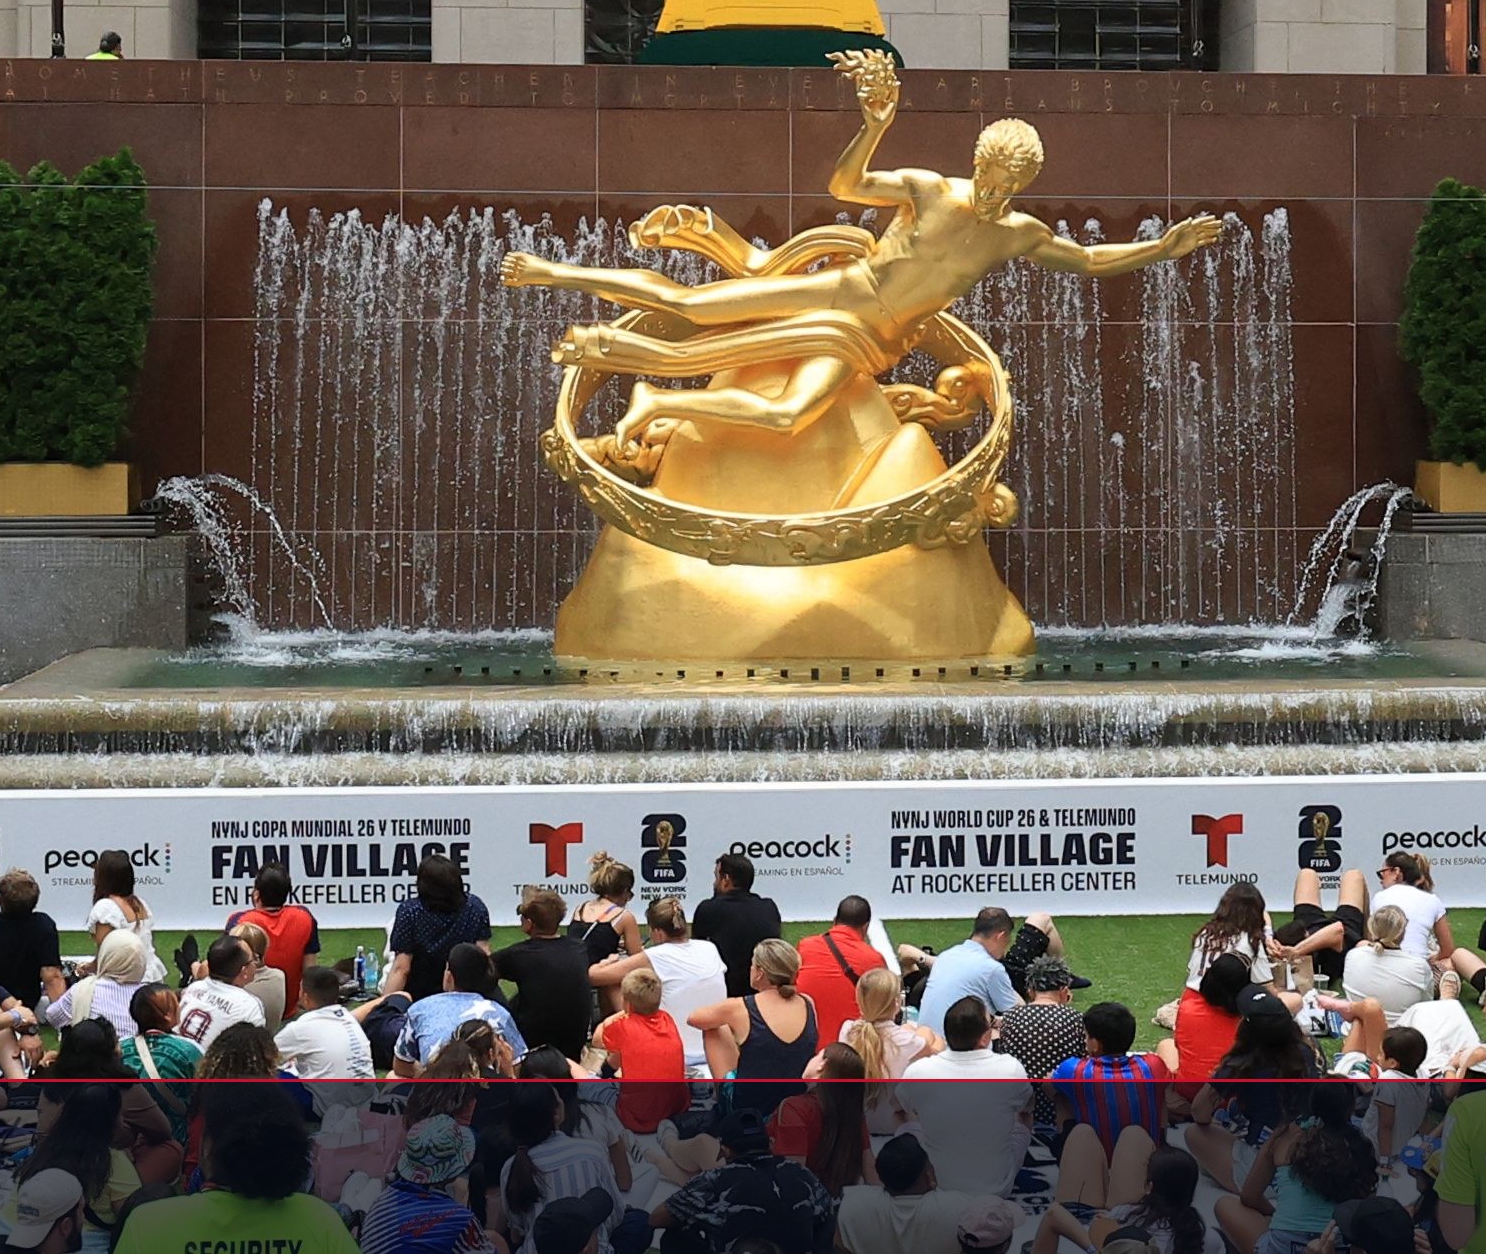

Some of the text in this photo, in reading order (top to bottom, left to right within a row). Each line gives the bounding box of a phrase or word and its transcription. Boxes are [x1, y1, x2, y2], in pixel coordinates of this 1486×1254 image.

[891, 808, 1136, 829] NYNJ WORLD CUP 26 & TELEMUNDO
[212, 818, 471, 839] NYNJ COPA MUNDIAL 26 Y TELEMUNDO
[891, 832, 1136, 868] FAN VILLAGE
[212, 844, 290, 879] FAN
[1310, 858, 1331, 868] FIFA
[1441, 858, 1451, 866] EN
[654, 869, 675, 878] FIFA
[791, 866, 845, 877] EN ESPAÑOL
[1176, 873, 1258, 885] TELEMUNDO
[891, 871, 1136, 894] AT ROCKEFELLER CENTER
[212, 886, 238, 905] EN
